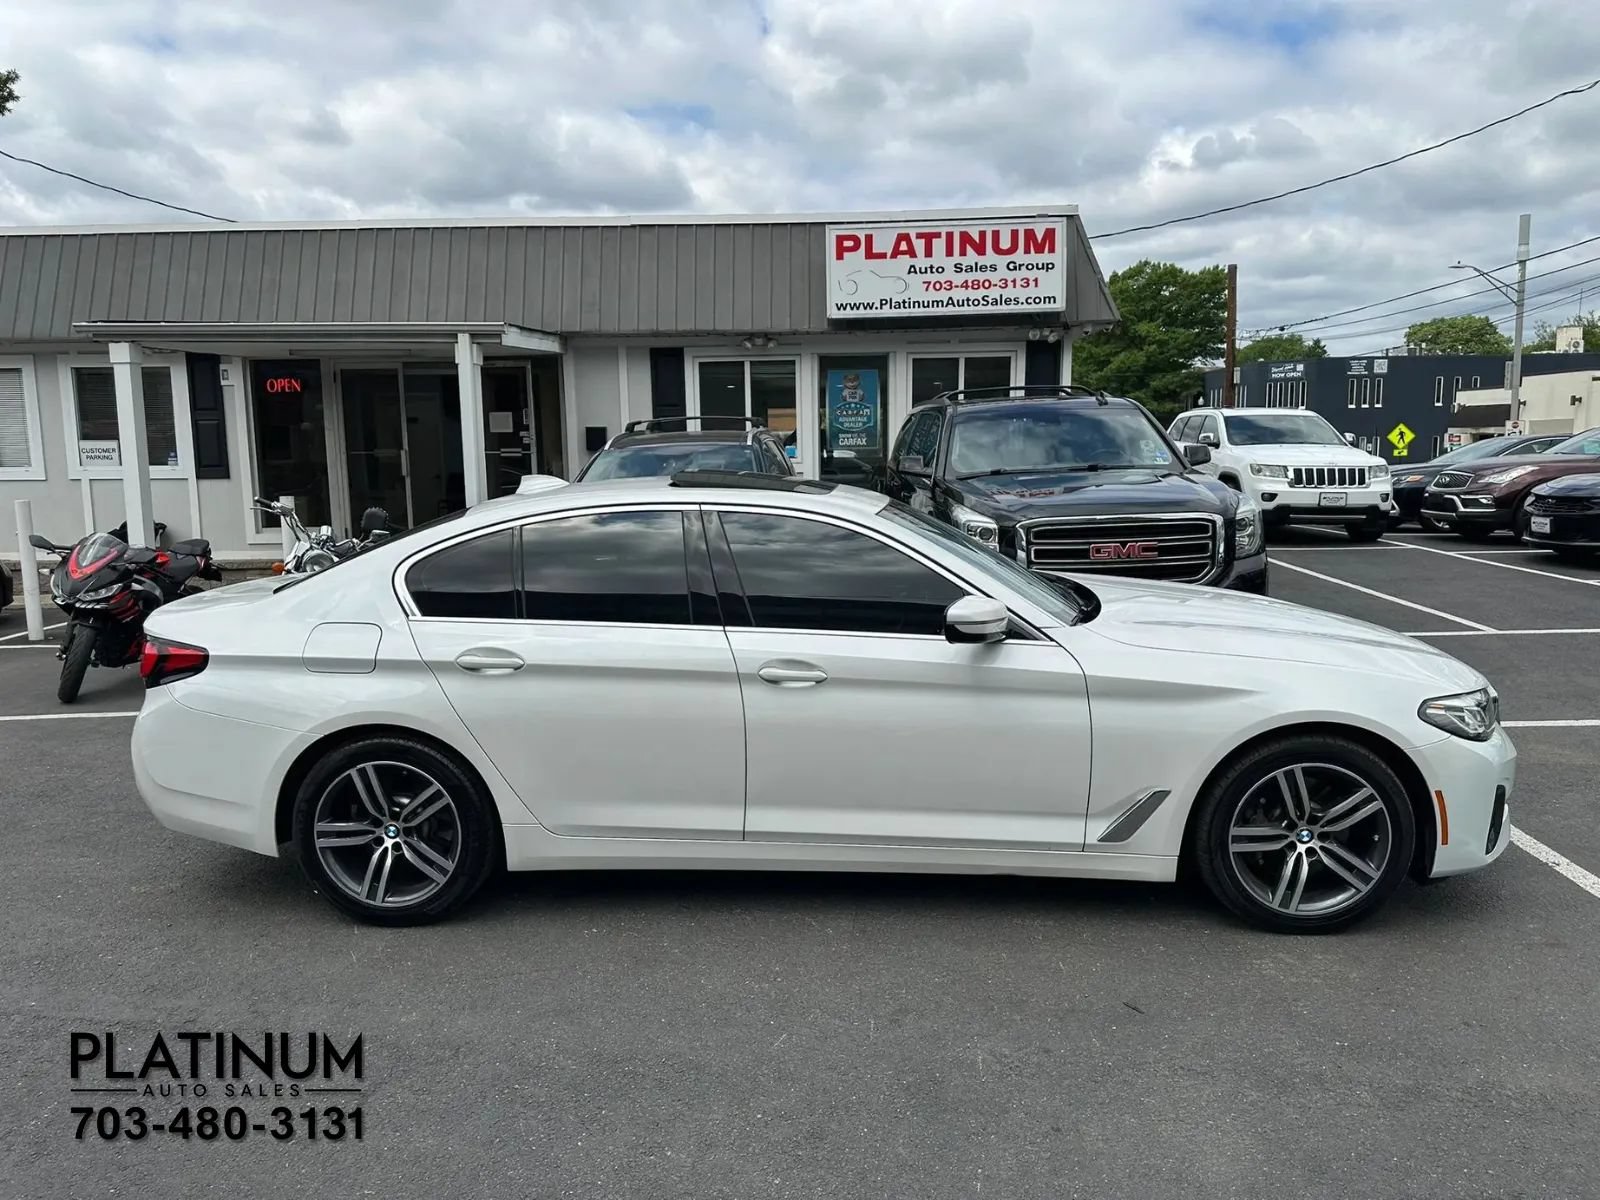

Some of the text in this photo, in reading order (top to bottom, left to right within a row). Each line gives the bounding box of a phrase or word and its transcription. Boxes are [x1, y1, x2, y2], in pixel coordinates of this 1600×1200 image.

[835, 227, 1056, 261] PLATINUM
[907, 260, 1056, 275] Auto Sales Group
[922, 277, 1040, 292] 703-480-3131
[835, 294, 1057, 312] www.PlatinumAutoSales.com
[266, 378, 301, 392] OPEN
[838, 437, 867, 446] CARFAX
[1090, 541, 1159, 560] GMC
